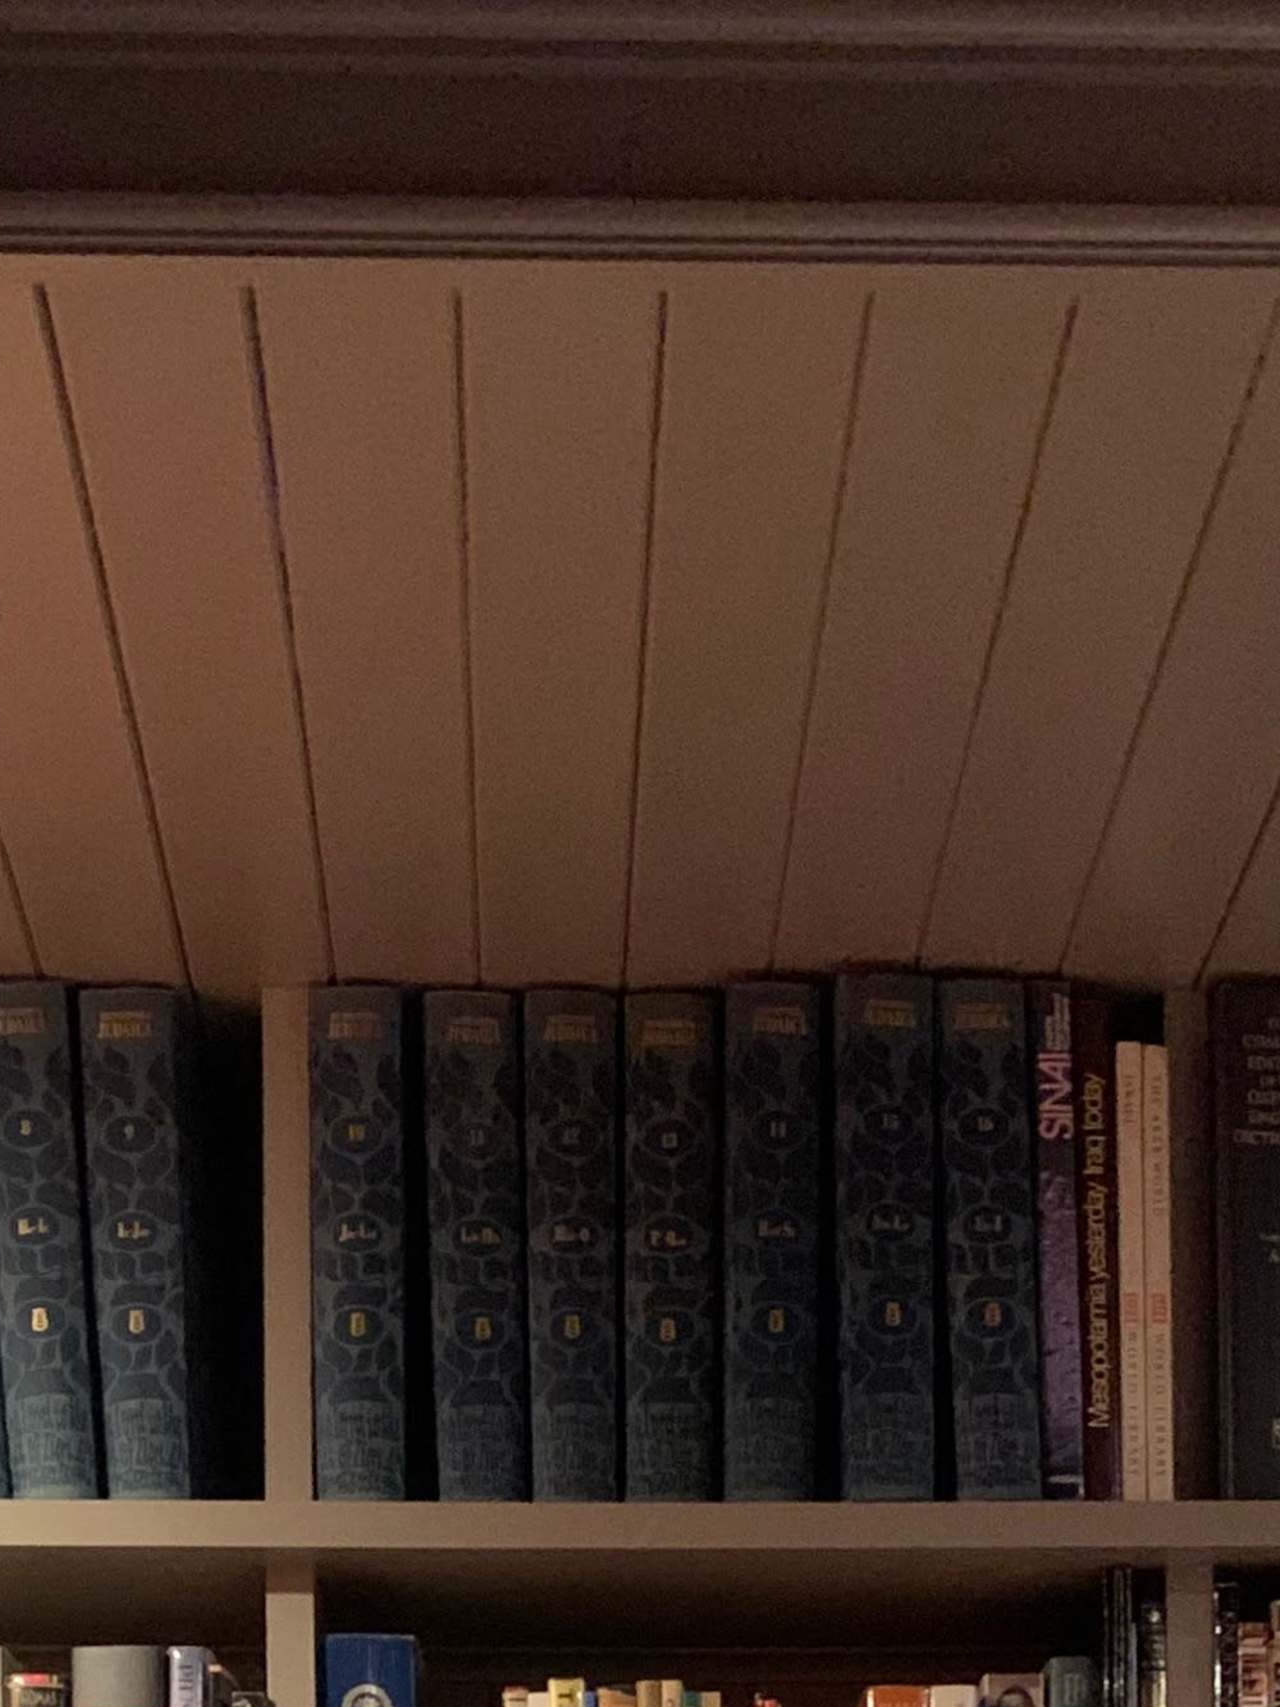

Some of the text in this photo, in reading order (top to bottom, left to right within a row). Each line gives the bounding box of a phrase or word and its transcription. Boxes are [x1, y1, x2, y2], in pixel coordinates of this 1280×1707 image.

[1038, 1051, 1075, 1141] SINAI
[1082, 1073, 1110, 1428] Mesopotamia yesterday Iraq today
